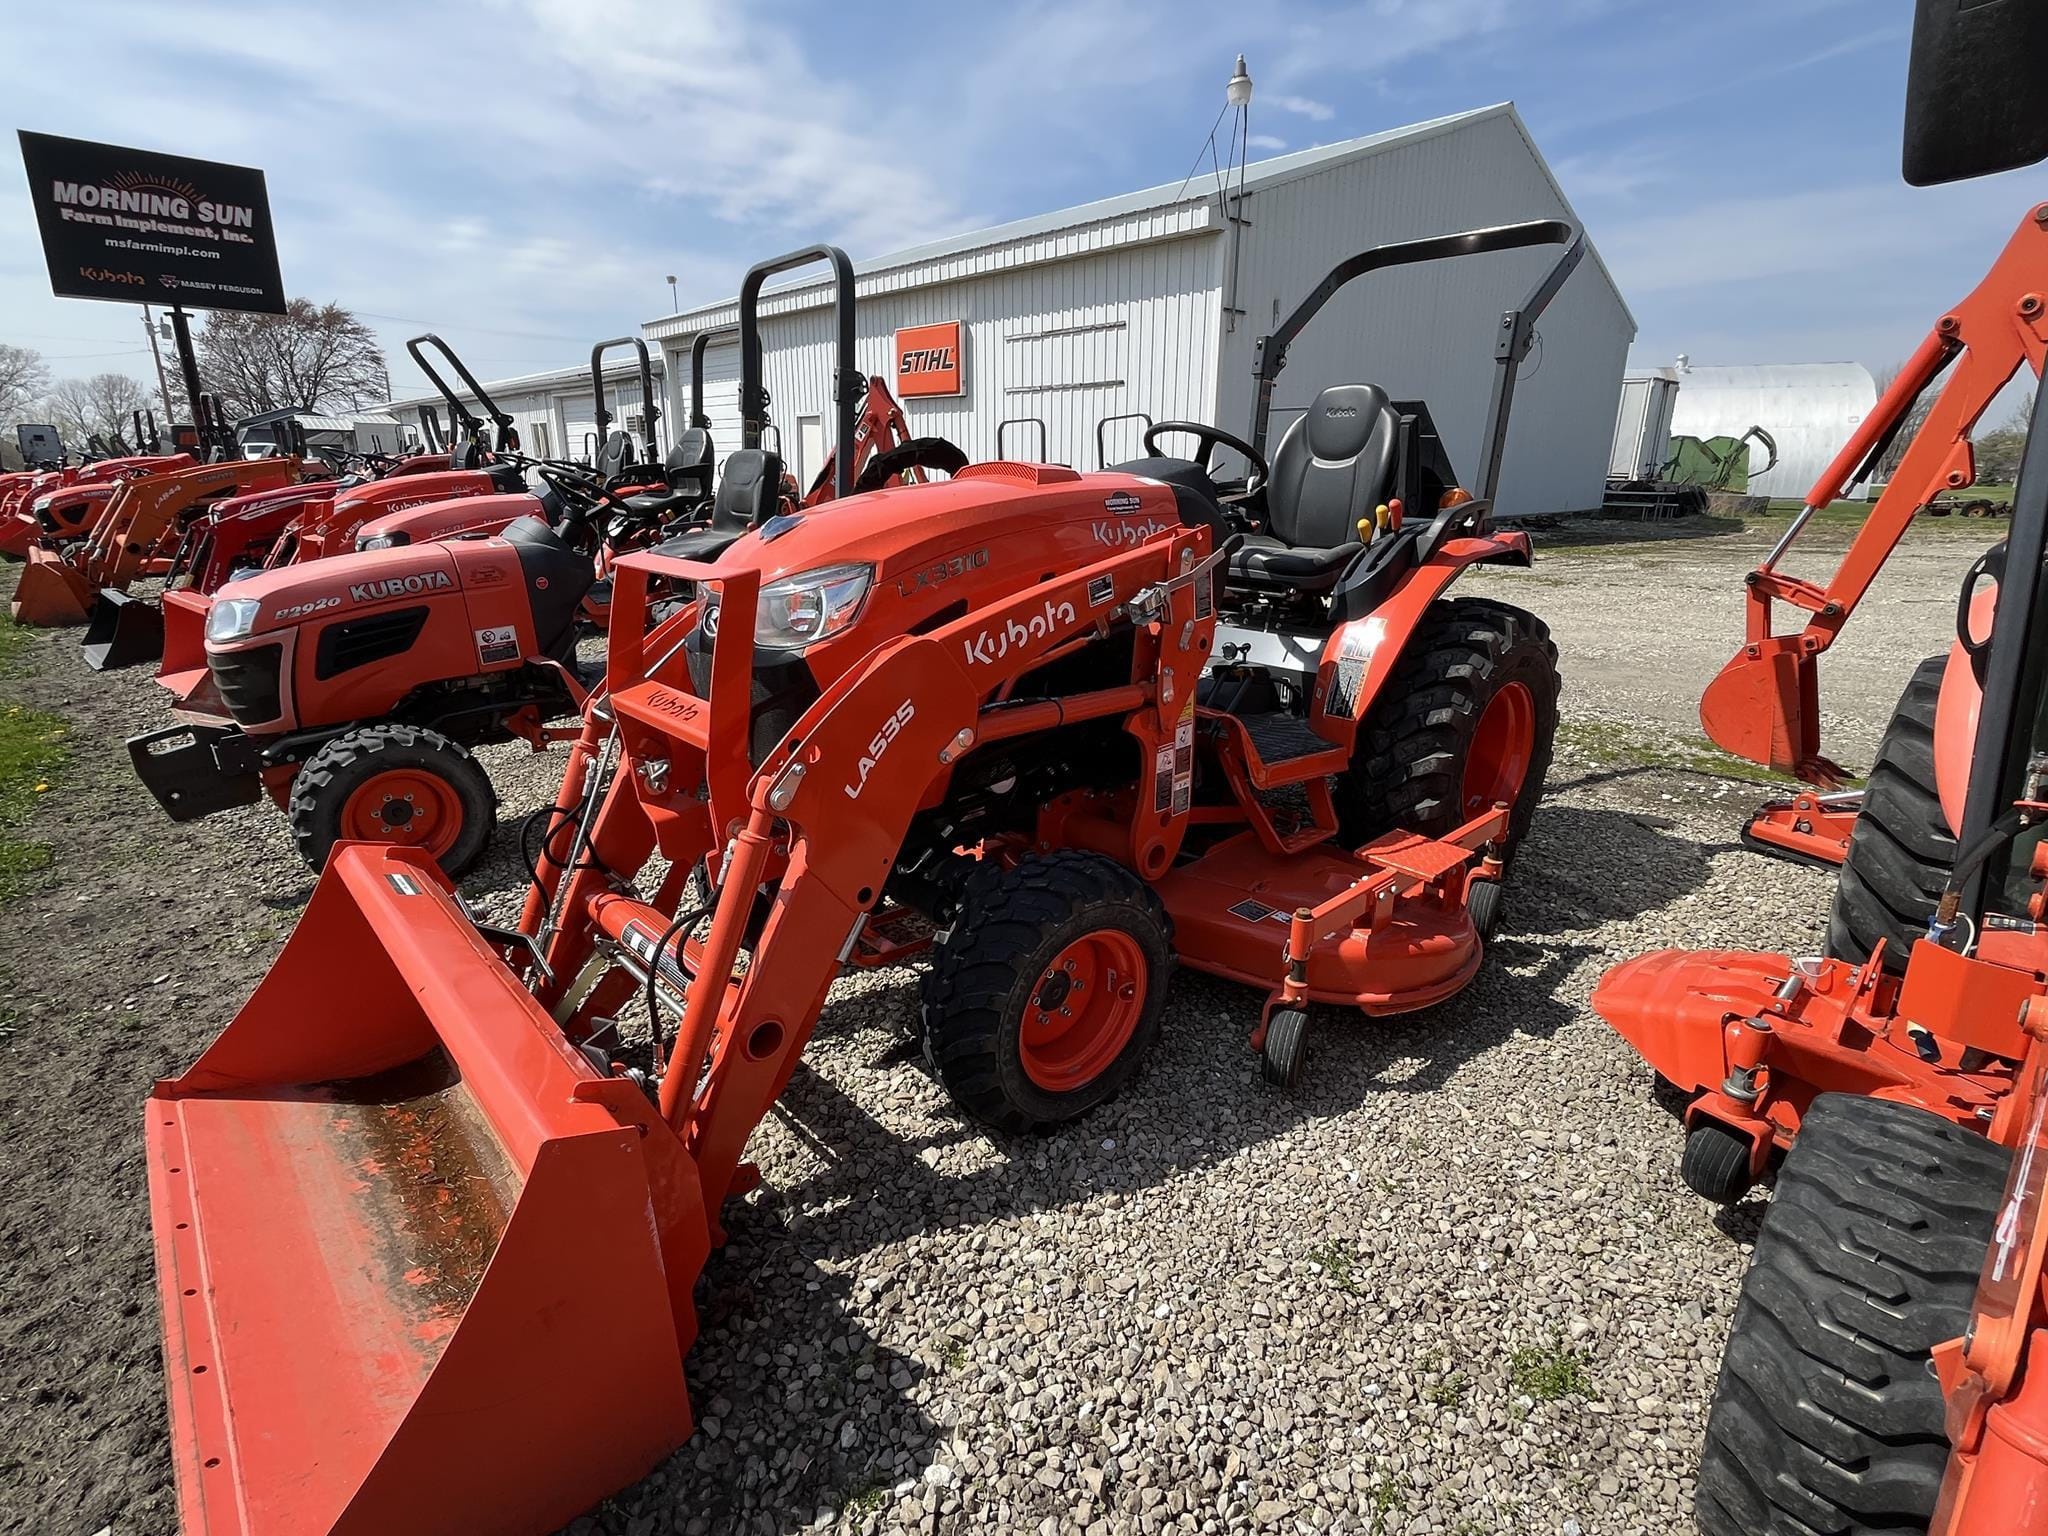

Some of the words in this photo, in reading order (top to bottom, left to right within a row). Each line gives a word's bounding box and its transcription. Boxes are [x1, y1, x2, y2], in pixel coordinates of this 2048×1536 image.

[53, 181, 189, 219] MORNING
[197, 202, 252, 227] SUN
[60, 208, 113, 226] Farm
[115, 215, 219, 240] Implement,
[222, 228, 254, 243] Inc.
[105, 238, 220, 259] msfarmimpl.com
[80, 266, 145, 285] Kubota
[180, 280, 216, 290] MASSEY
[218, 284, 263, 295] FERGUSON
[899, 348, 954, 374] STIHL
[350, 570, 452, 602] KUBOTA
[897, 549, 989, 598] LX3310
[275, 597, 341, 620] B2920
[963, 600, 1076, 665] Kubota
[647, 690, 699, 721] Kubota
[844, 698, 915, 800] LA535
